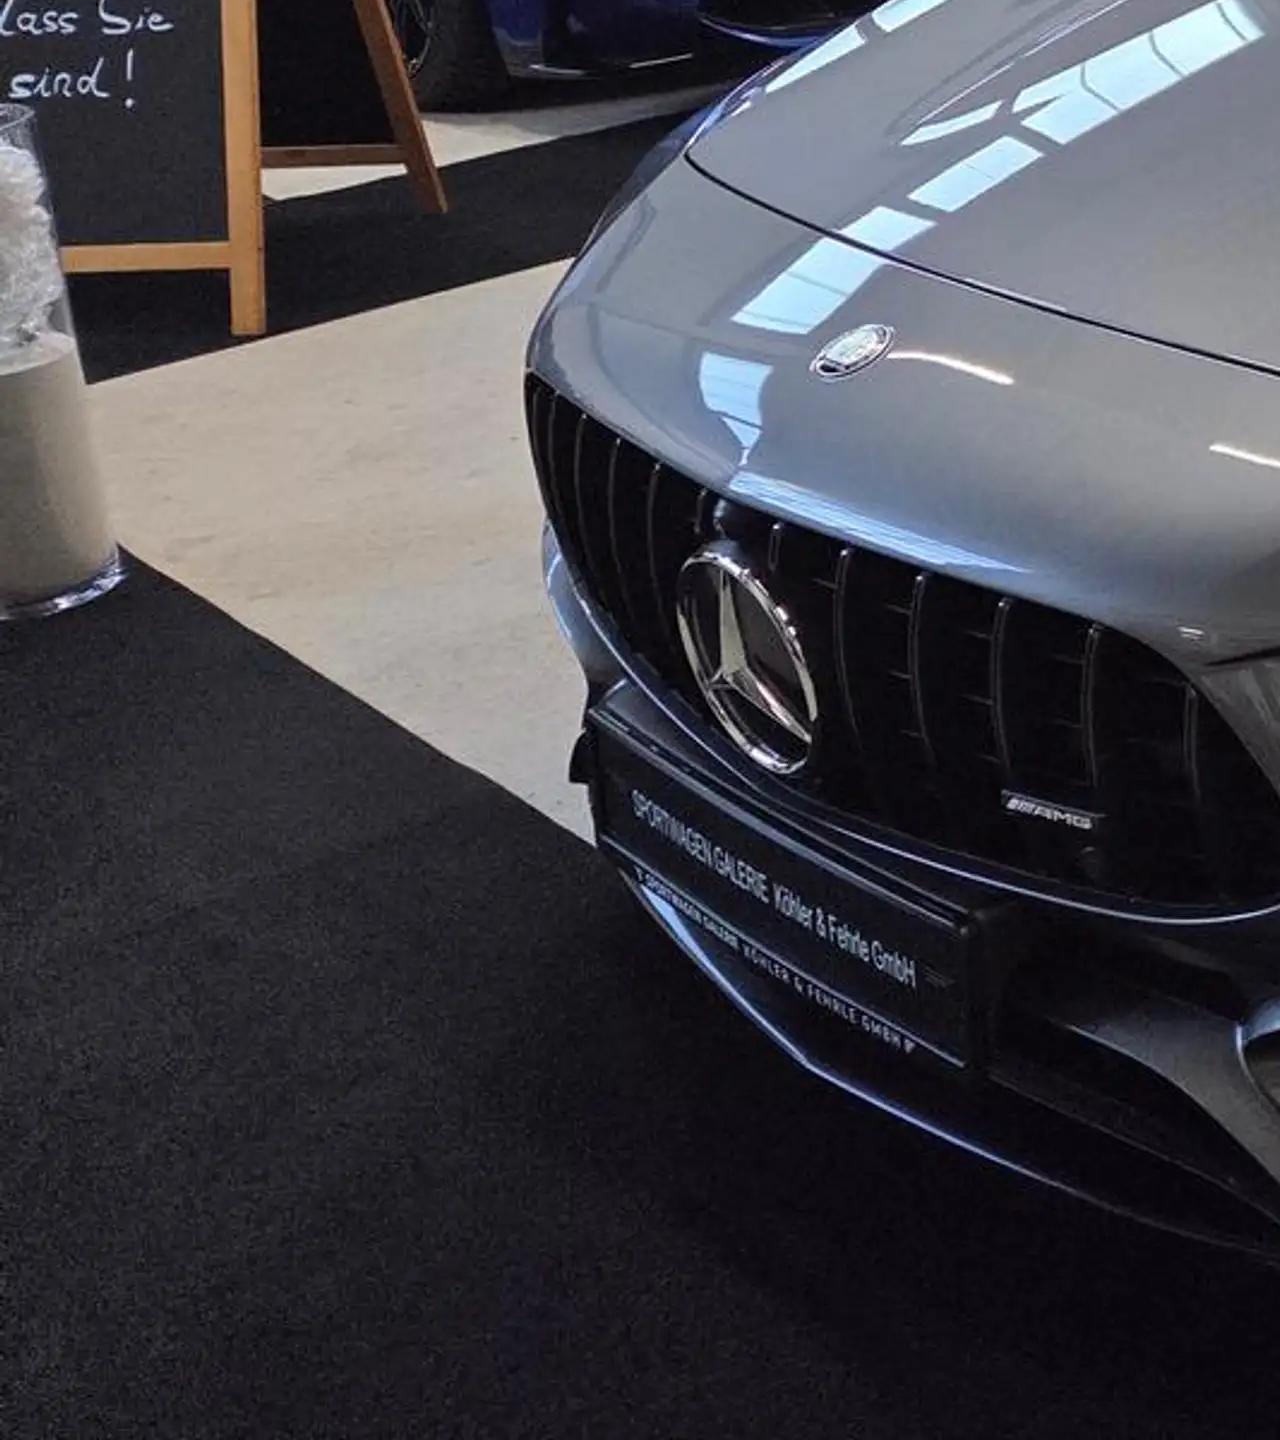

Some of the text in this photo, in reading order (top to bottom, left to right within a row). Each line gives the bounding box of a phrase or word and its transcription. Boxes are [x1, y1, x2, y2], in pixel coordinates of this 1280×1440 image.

[630, 788, 714, 869] SPORTWAGEN
[713, 845, 770, 904] GALERIE
[815, 907, 827, 939] &
[828, 913, 870, 962] Fehrle
[871, 940, 917, 989] GmbH
